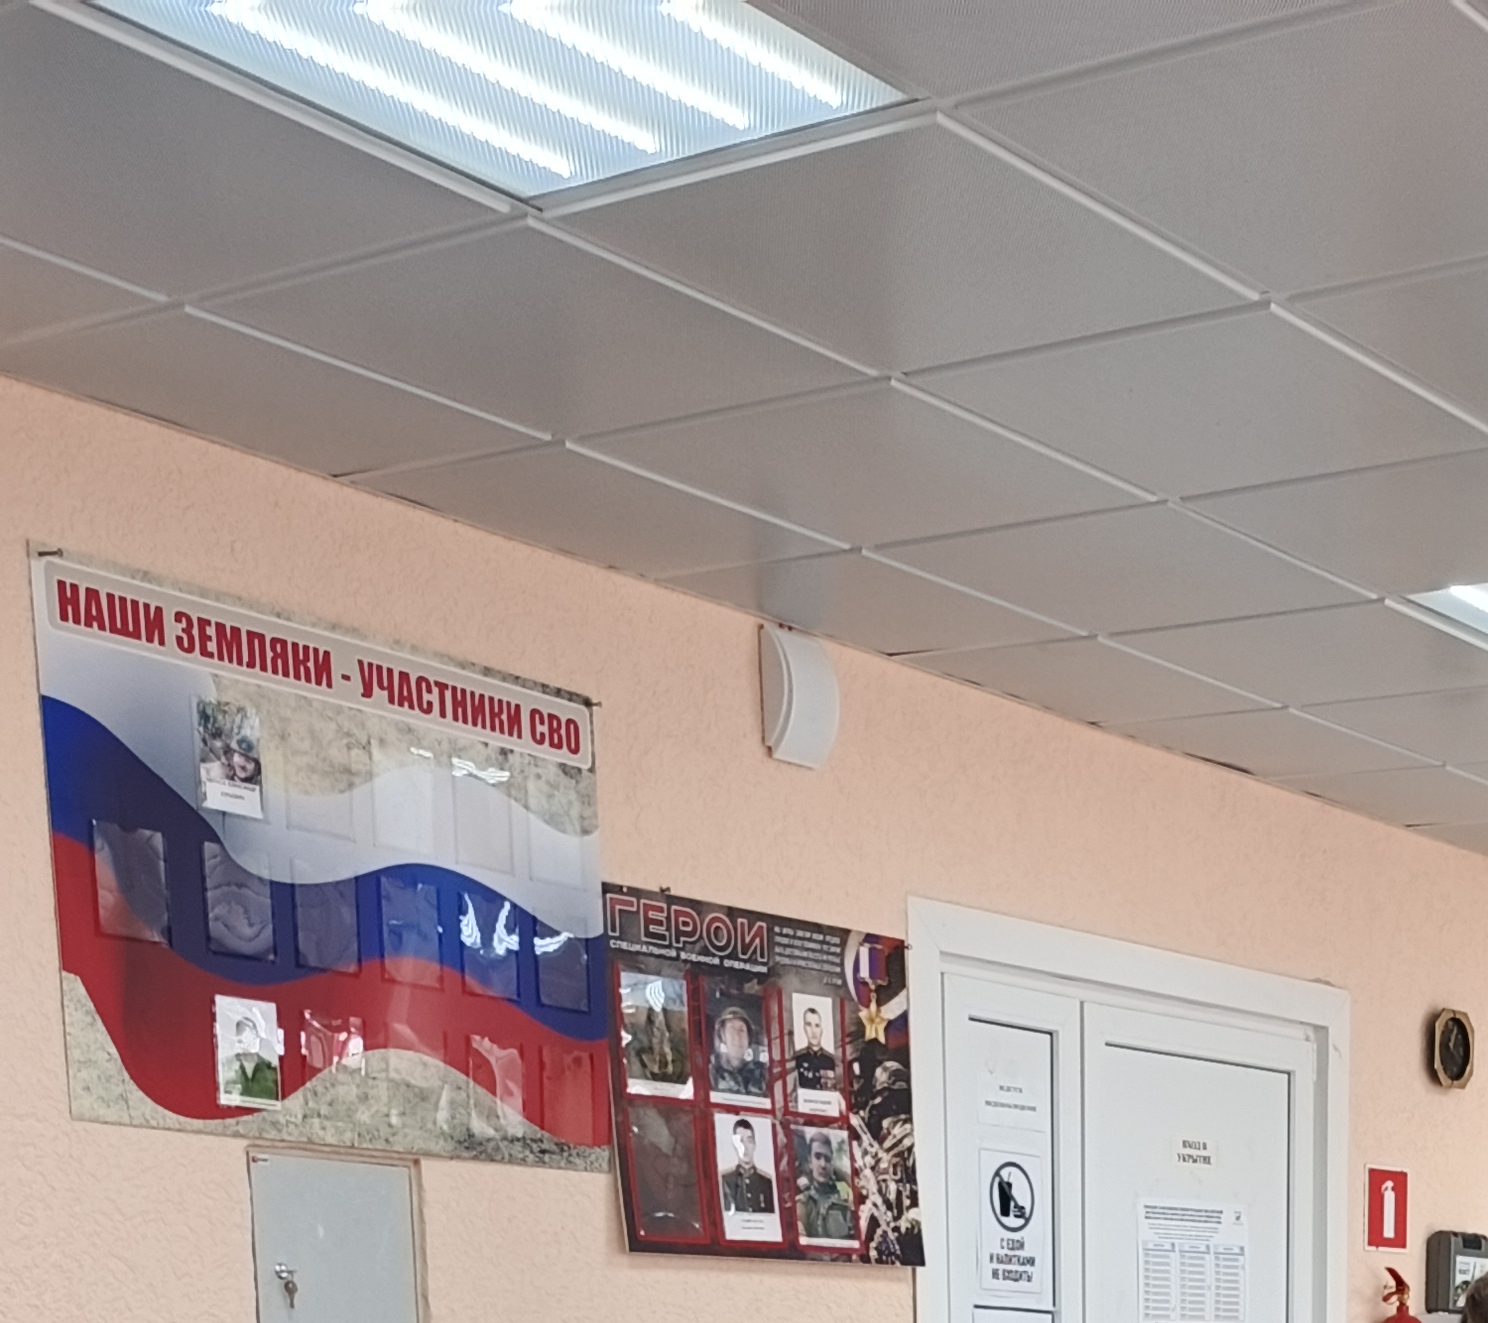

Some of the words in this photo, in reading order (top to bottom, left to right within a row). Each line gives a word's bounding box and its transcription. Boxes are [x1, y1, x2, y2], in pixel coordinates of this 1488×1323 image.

[57, 579, 165, 647] НАШИ
[174, 610, 333, 690] ЗЕМЛЯКИ
[357, 659, 523, 740] УЧАСТНИКИ
[529, 707, 581, 756] СВО
[606, 893, 768, 963] ГЕРОИ
[610, 938, 677, 959] СПЕЦИАЛЬНОЙ
[680, 951, 720, 966] ВОЕННОЙ
[723, 958, 768, 974] ОПЕРАЦИИ
[1182, 1140, 1201, 1151] ВХОД
[1177, 1153, 1212, 1166] УКРЫТИЕ
[1000, 1237, 1005, 1250] С
[1006, 1236, 1025, 1251] ЕДОЙ
[996, 1253, 1036, 1267] НАПИТКАМИ
[991, 1268, 1000, 1280] НЕ
